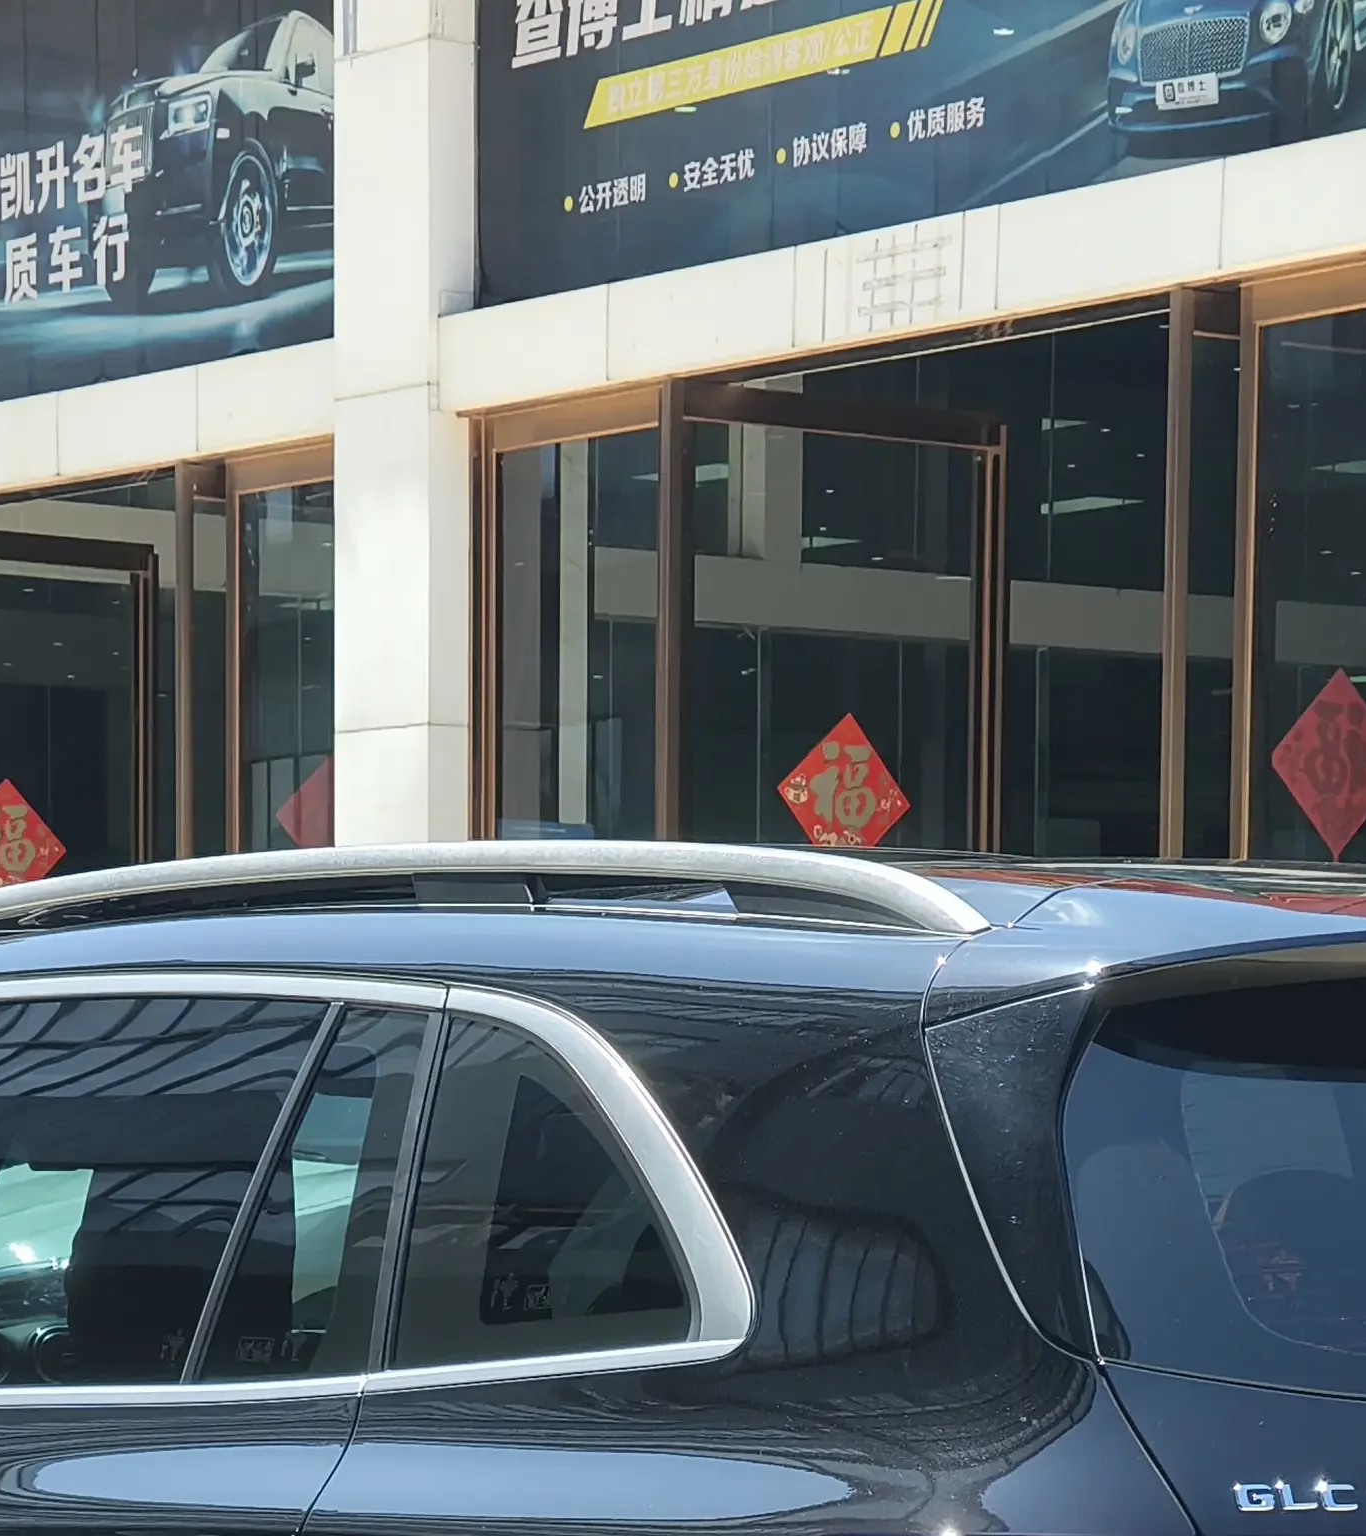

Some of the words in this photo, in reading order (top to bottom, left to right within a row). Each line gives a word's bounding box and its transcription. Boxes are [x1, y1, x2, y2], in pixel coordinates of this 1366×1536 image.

[579, 173, 647, 214] 公开透明
[683, 148, 756, 192] 安全无忧
[792, 122, 868, 167] 协议保障
[906, 96, 986, 141] 优质服务
[809, 742, 876, 829] 福
[1234, 1481, 1359, 1512] GLC
